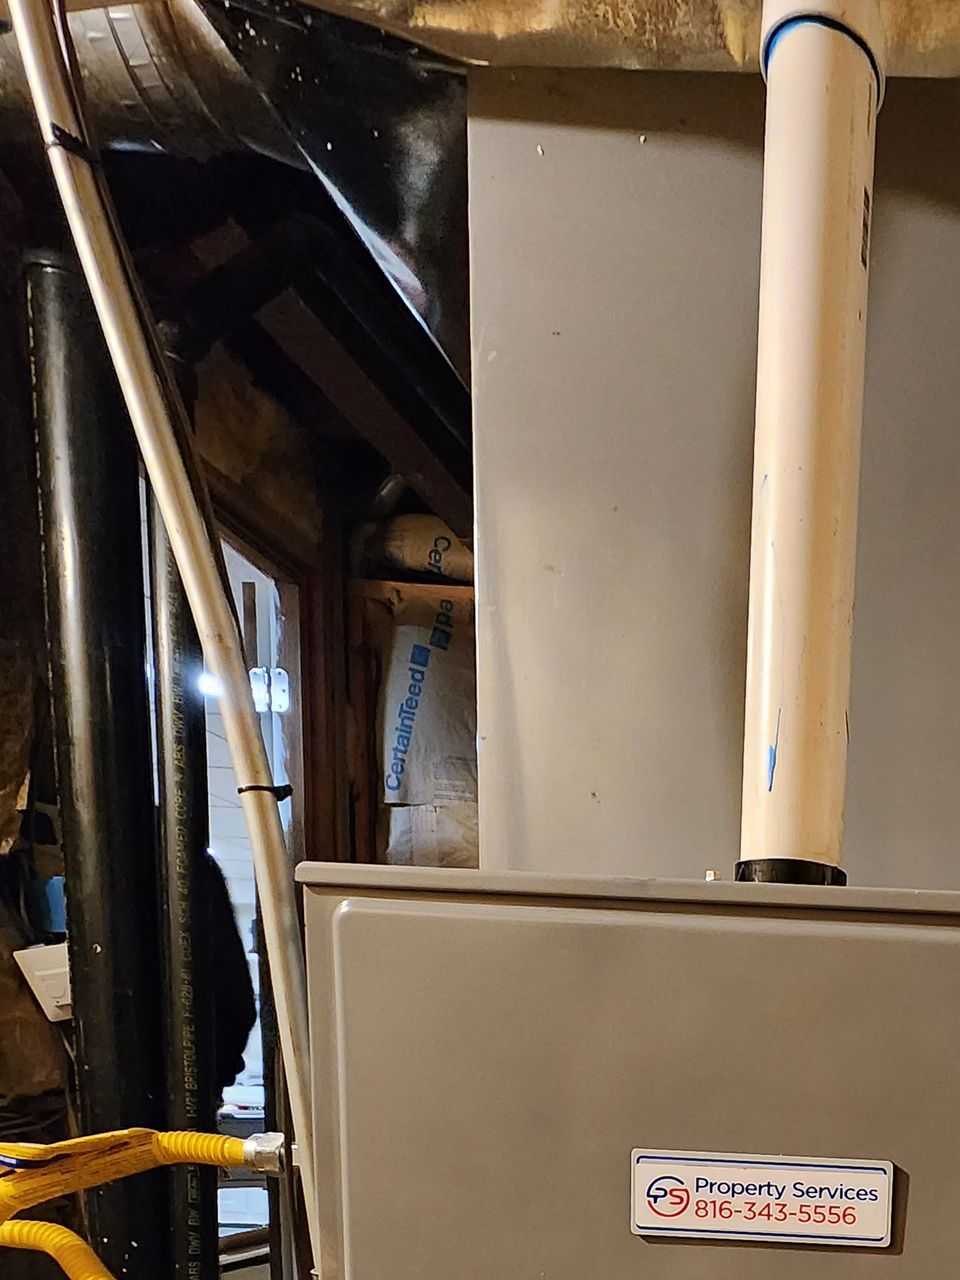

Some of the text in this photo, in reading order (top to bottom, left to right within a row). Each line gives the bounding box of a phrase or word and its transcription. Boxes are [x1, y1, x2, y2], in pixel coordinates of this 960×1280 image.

[385, 667, 426, 791] CertainTeed
[695, 1177, 879, 1202] Property Services
[694, 1199, 857, 1226] 816-343-5556
